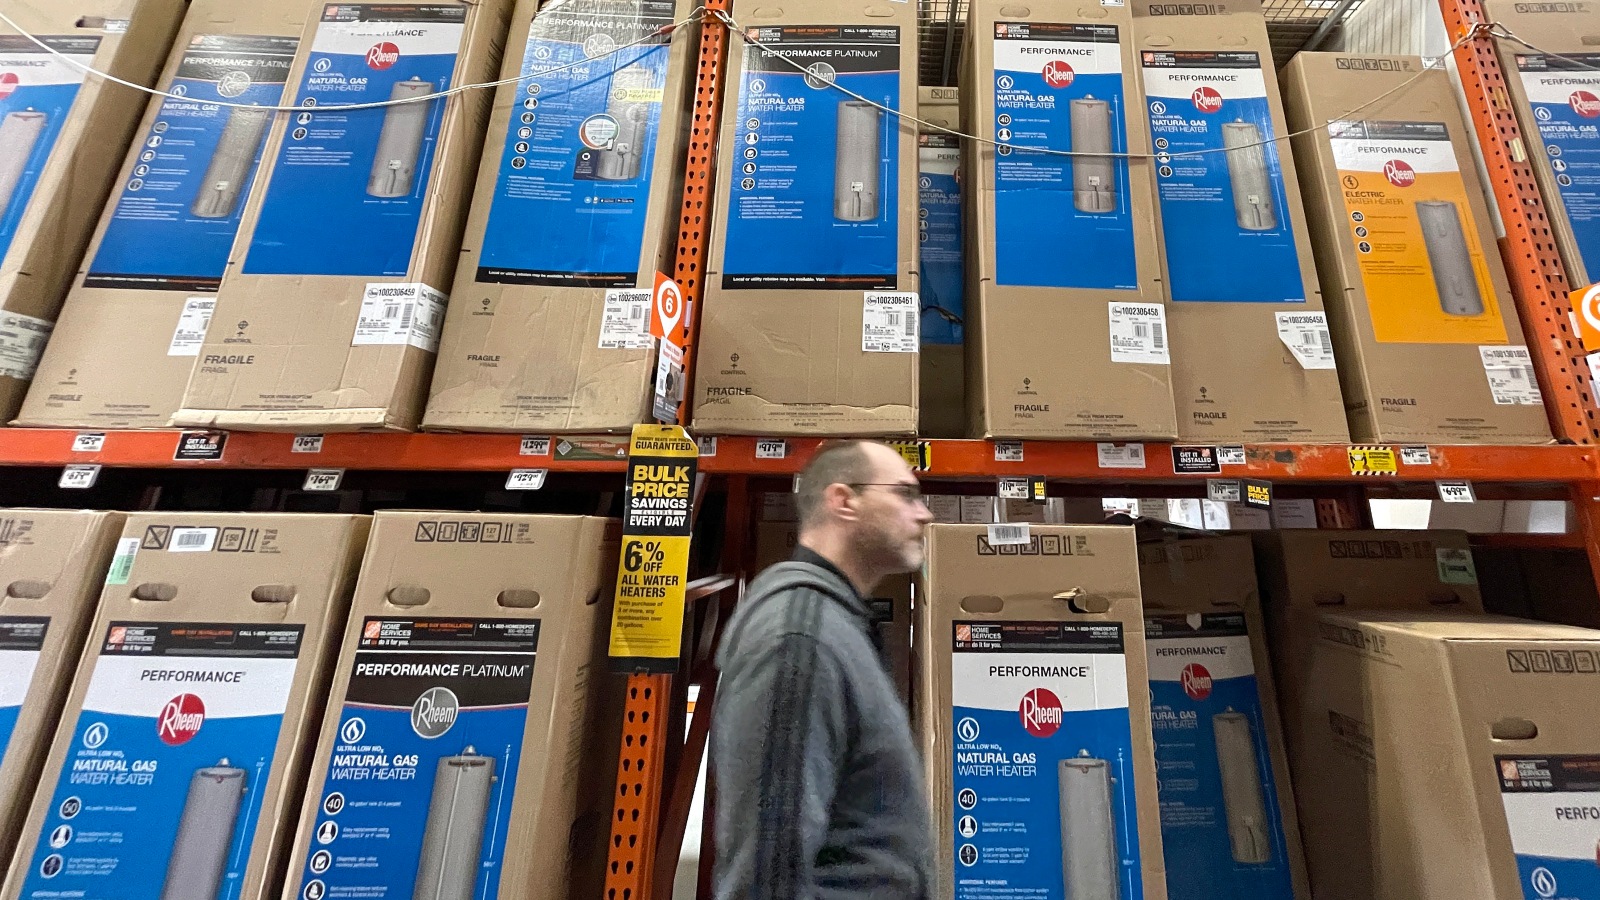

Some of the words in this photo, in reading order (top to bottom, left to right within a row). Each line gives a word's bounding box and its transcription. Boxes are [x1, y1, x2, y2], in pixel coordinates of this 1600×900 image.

[543, 18, 614, 27] PERFORMANCE
[367, 42, 398, 67] Rheem
[761, 49, 832, 59] PERFORMANCE
[834, 51, 879, 59] PLATINUM
[1021, 48, 1092, 56] PERFORMANCE
[256, 60, 291, 69] PLATINU
[1045, 61, 1074, 85] Rheem
[1169, 74, 1237, 82] PERFORMANCE
[307, 84, 332, 92] WATER
[335, 85, 366, 93] HEATER
[1195, 87, 1223, 110] Rheem
[162, 103, 201, 111] NATURAL
[1152, 119, 1188, 127] NATURAL
[1358, 146, 1427, 155] PERFORMANCE
[1385, 160, 1415, 184] Rheem
[1345, 190, 1386, 198] ELECTRIC
[1347, 198, 1373, 206] WATER
[666, 297, 678, 314] 6
[1121, 307, 1159, 317] 1002306458
[203, 355, 255, 365] FRAGILE
[707, 387, 753, 396] FRAGILE
[1381, 397, 1417, 406] FRAGILE
[1014, 404, 1050, 412] FRAGILE
[1193, 411, 1228, 419] FRAGILE
[635, 441, 693, 451] GUARANTEED.
[1180, 451, 1191, 459] GET
[633, 464, 690, 482] BULK
[632, 481, 690, 498] PRICE
[1247, 484, 1269, 495] BULK
[1247, 492, 1270, 501] PRICE
[631, 498, 688, 509] SAVINGS
[629, 515, 662, 527] EVERY
[664, 516, 687, 527] DAY
[643, 562, 663, 573] OFF
[621, 574, 640, 585] ALL
[643, 575, 679, 586] WATER
[620, 586, 666, 598] HEATERS
[380, 629, 412, 637] SERVICES
[971, 632, 1002, 640] SERVICES
[1156, 646, 1226, 657] PERFORMANCE
[355, 663, 460, 677] PERFORMANCE
[1182, 663, 1212, 696] Rheem
[416, 689, 455, 730] Rheem
[1023, 688, 1062, 731] Rheem
[159, 694, 204, 739] Rheem
[1180, 711, 1197, 720] GAS
[333, 754, 390, 767] NATURAL
[392, 755, 419, 767] GAS
[957, 752, 1010, 764] NATURAL
[1012, 753, 1036, 764] GAS
[73, 760, 128, 773] NATURAL
[131, 761, 157, 773] GAS
[957, 765, 994, 777] WATER
[995, 765, 1037, 778] HEATER
[70, 773, 108, 786] WATER
[109, 774, 154, 787] HEATER
[331, 768, 369, 781] WATER
[371, 769, 416, 781] HEATER
[327, 798, 340, 809] 40
[961, 794, 974, 804] 40
[63, 803, 78, 814] 50
[1555, 807, 1600, 821] PERFO
